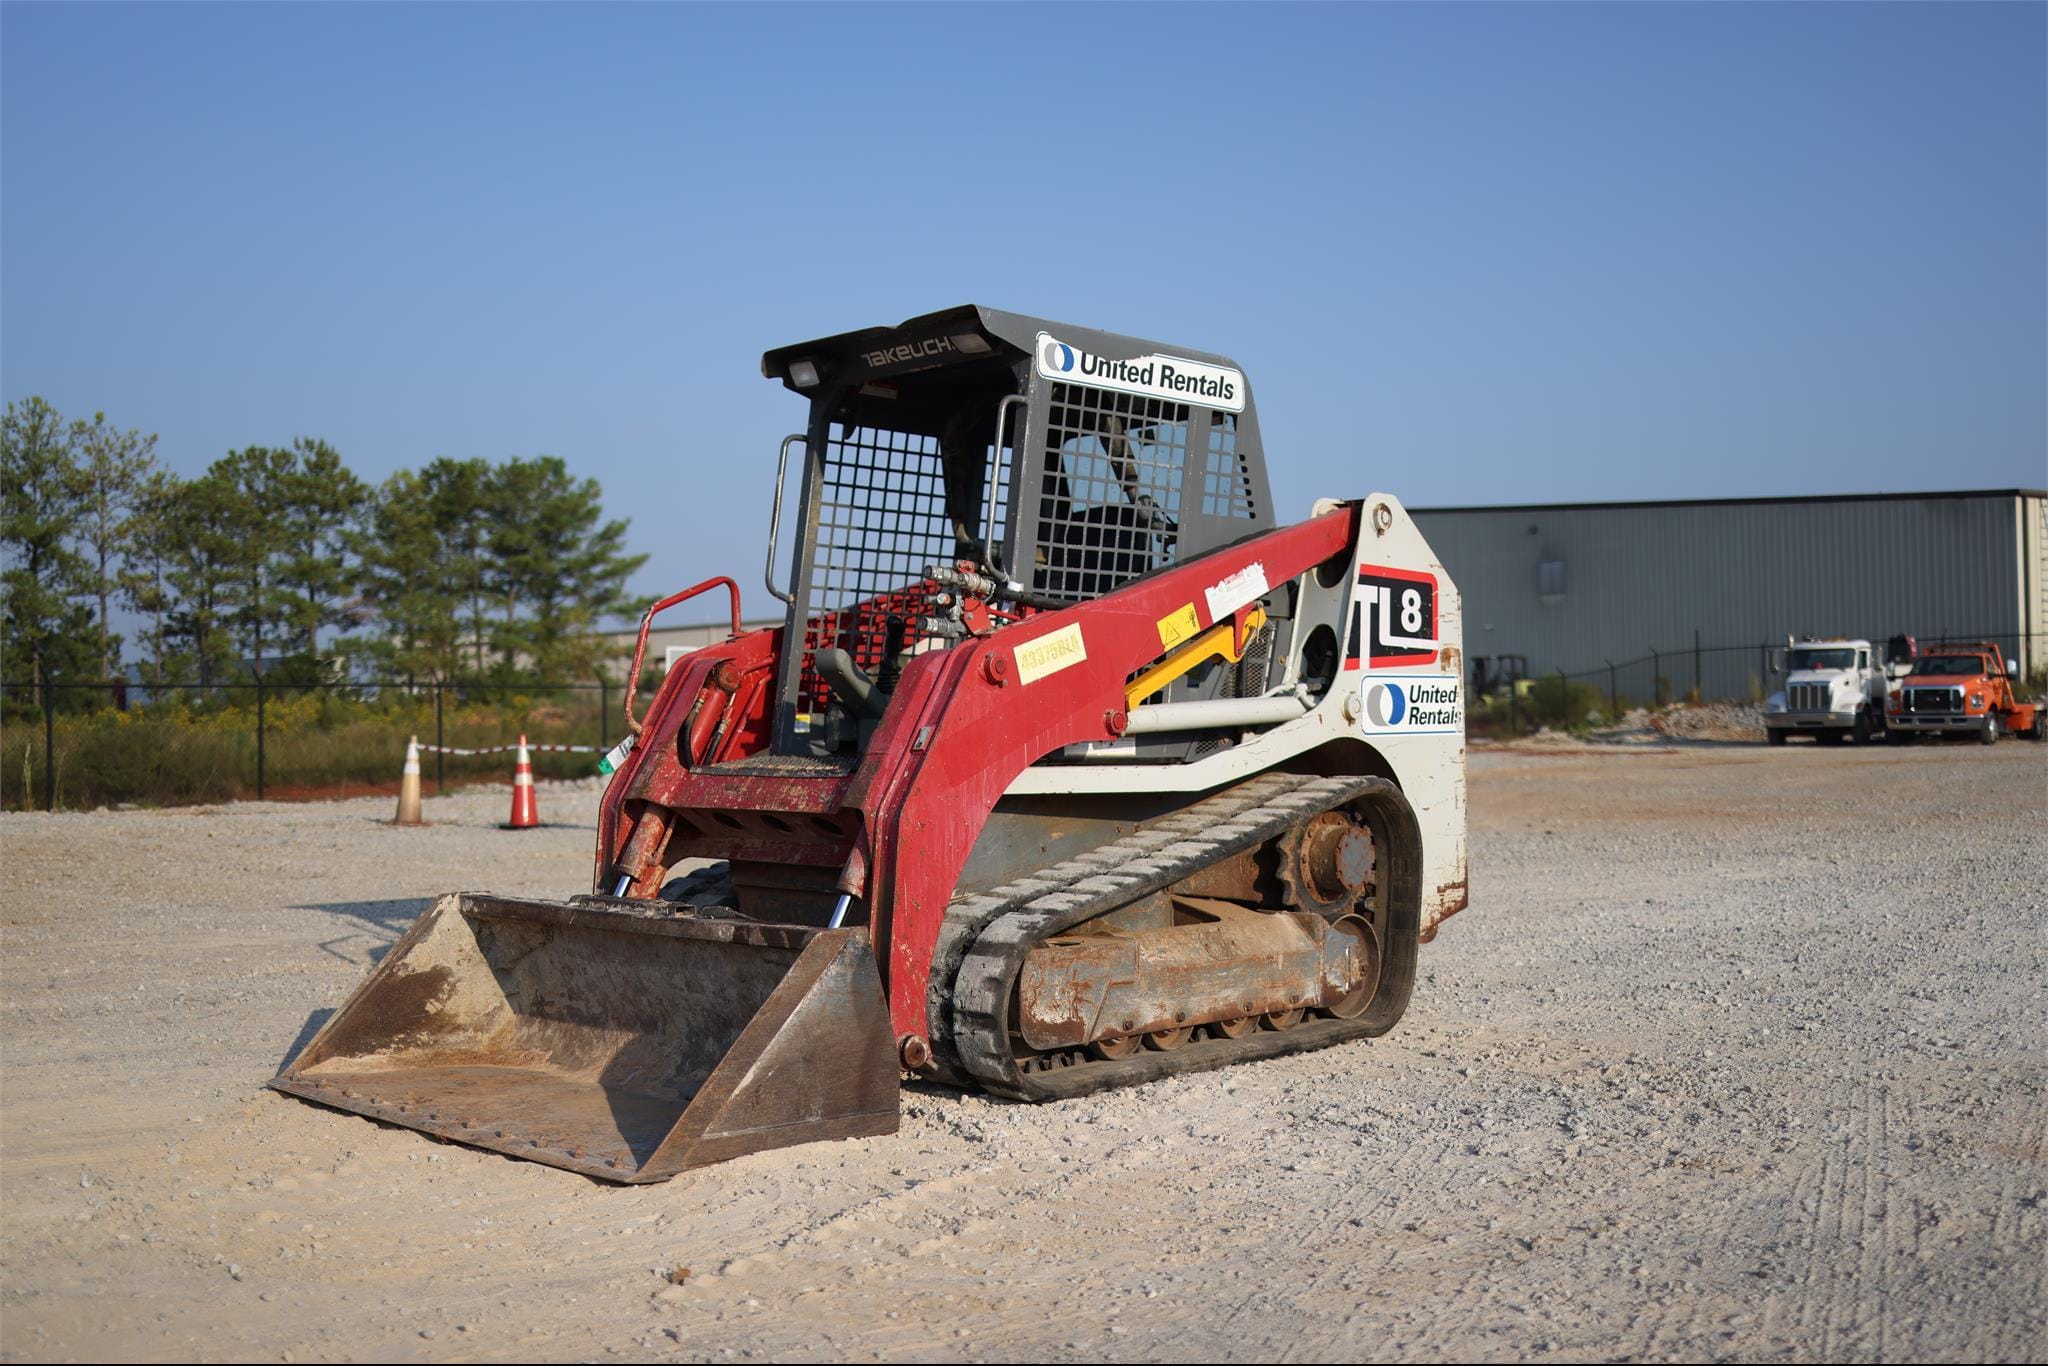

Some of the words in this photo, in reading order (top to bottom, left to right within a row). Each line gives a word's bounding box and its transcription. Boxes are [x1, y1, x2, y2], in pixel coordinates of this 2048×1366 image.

[1080, 351, 1154, 386] United
[1160, 364, 1234, 400] Rentals
[1409, 685, 1457, 704] United
[1408, 707, 1461, 725] Rentals
